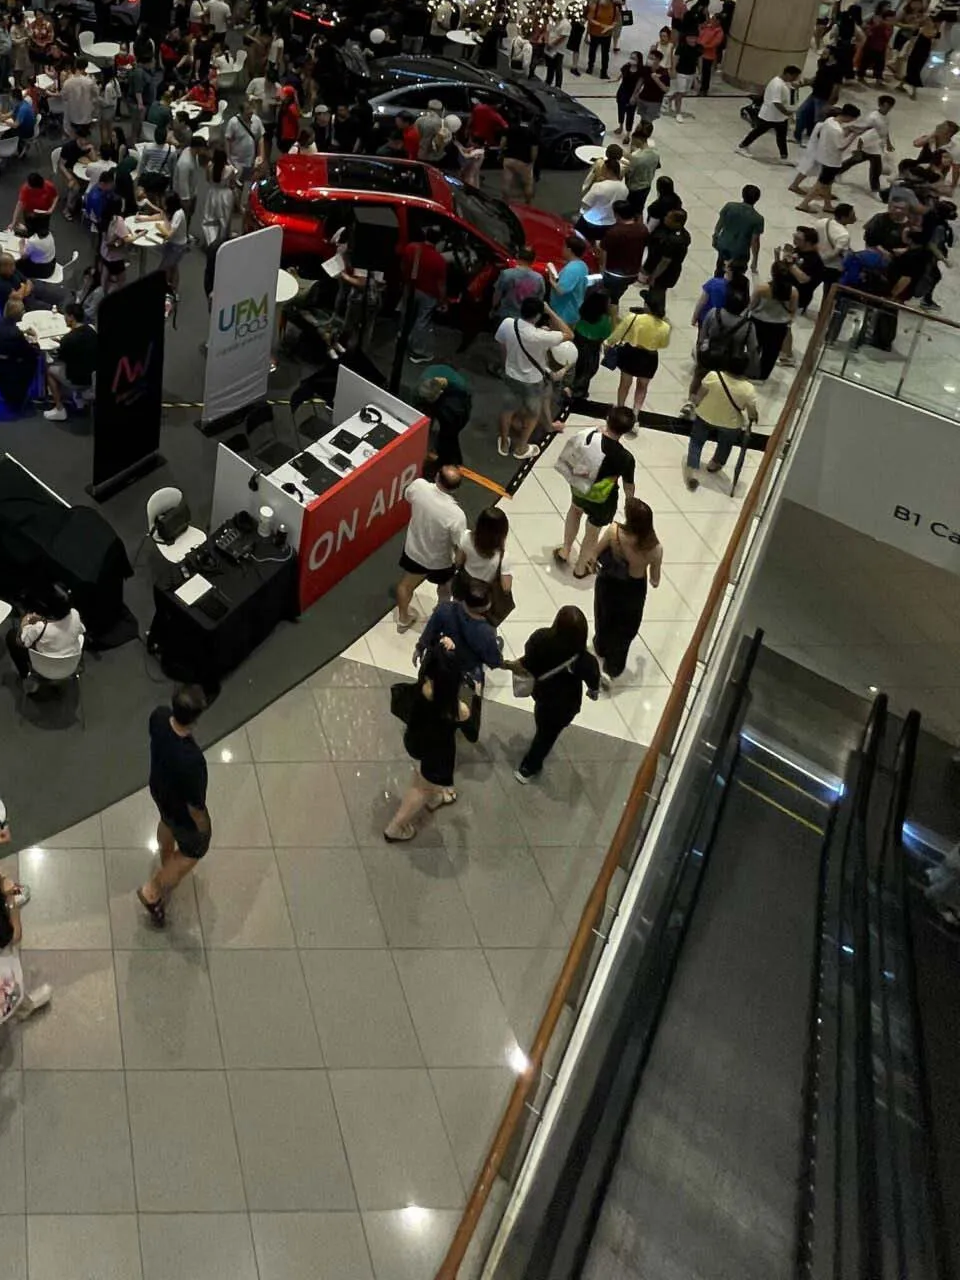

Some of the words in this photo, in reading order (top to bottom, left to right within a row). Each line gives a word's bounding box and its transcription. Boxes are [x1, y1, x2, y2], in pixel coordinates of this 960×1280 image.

[218, 292, 270, 332] UFM
[893, 505, 922, 527] B1
[308, 507, 359, 571] ON
